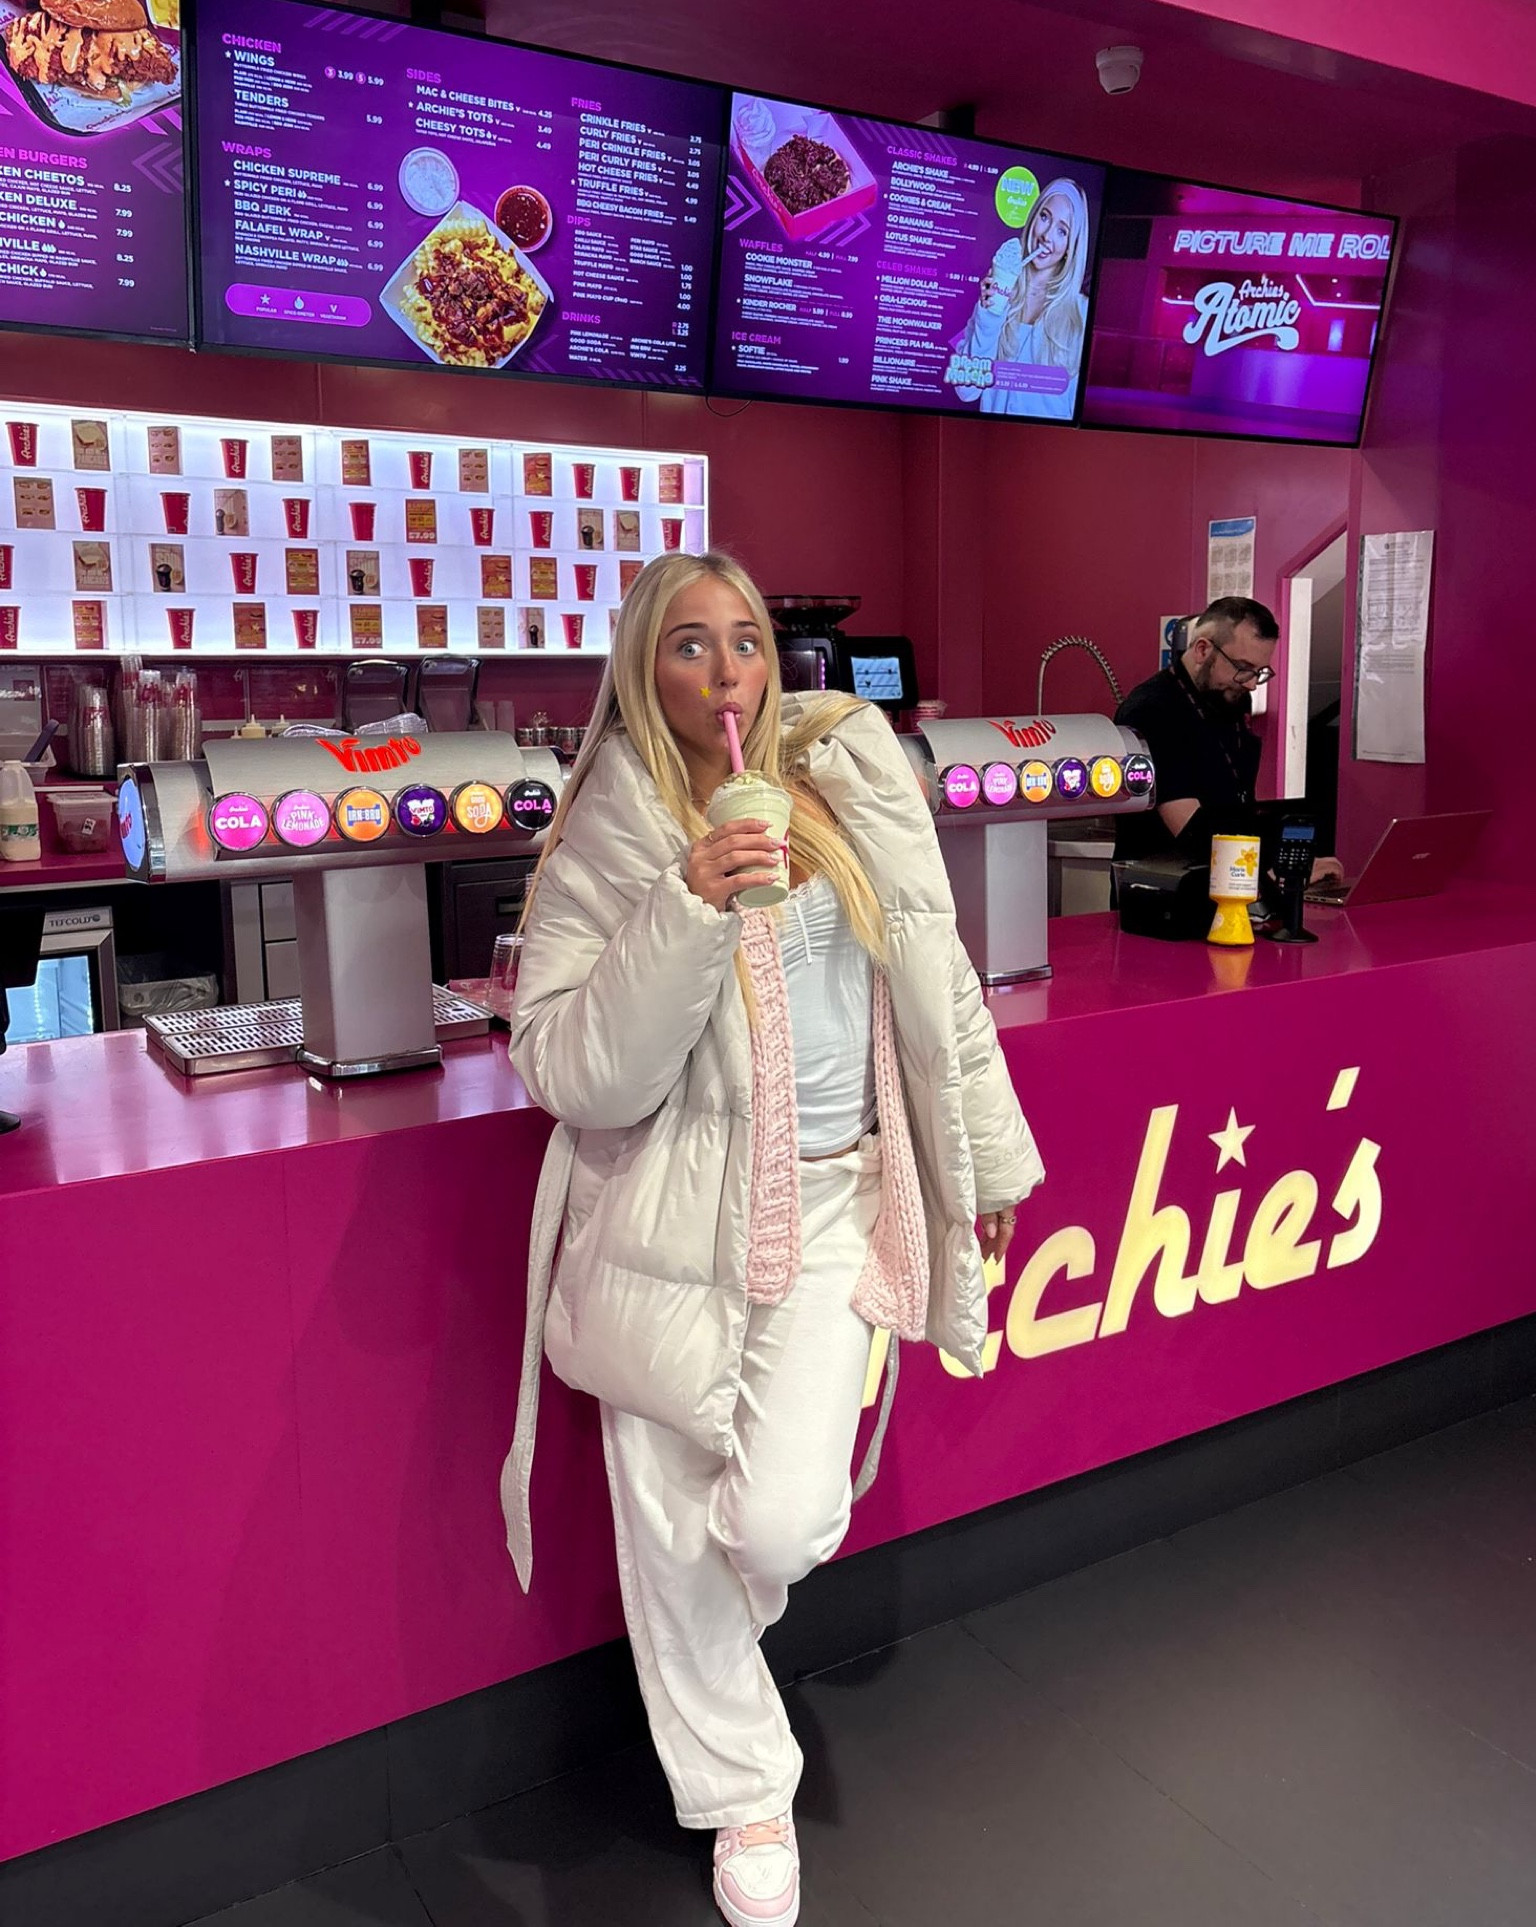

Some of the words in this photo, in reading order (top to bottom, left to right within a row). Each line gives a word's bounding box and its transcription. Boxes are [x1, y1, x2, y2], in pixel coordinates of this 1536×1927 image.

[222, 33, 282, 53] CHICKEN
[234, 50, 275, 67] WINGS
[406, 68, 442, 84] SIDES
[234, 88, 289, 108] TENDERS
[416, 84, 439, 97] MAC
[440, 89, 447, 99] &
[448, 91, 486, 107] CHEESE
[487, 98, 515, 111] BITES
[571, 97, 602, 112] FRIES
[416, 101, 466, 119] ARCHIE'S
[467, 110, 494, 124] TOTS
[415, 117, 457, 133] CHEESY
[459, 125, 486, 139] TOTS
[580, 113, 620, 129] CRINKLE
[620, 120, 646, 133] FRIES
[580, 126, 610, 139] CURLY
[611, 131, 637, 144] FRIES
[221, 141, 272, 158] WRAPS
[579, 137, 601, 150] PERI
[601, 142, 640, 156] CRINKLE
[641, 149, 667, 161] FRIES
[887, 146, 923, 160] CLASSIC
[923, 152, 958, 167] SHAKES
[19, 149, 88, 169] BURGERS
[578, 150, 600, 162] PERI
[601, 154, 630, 167] CURLY
[631, 159, 657, 171] FRIES
[24, 169, 85, 186] CHEETOS
[233, 160, 285, 177] CHICKEN
[288, 168, 341, 185] SUPREME
[578, 162, 597, 172] HOT
[597, 165, 632, 178] CHEESE
[633, 171, 659, 184] FRIES
[924, 166, 949, 179] SHAKE
[114, 183, 132, 193] 8.25
[234, 179, 268, 193] SPICY
[271, 185, 297, 198] PERI
[578, 177, 618, 192] TRUFFLE
[619, 184, 644, 197] FRIES
[890, 176, 937, 192] BOLLYWOOD
[1000, 176, 1035, 196] NEW
[26, 194, 77, 211] DELUXE
[234, 199, 260, 211] BBQ
[262, 203, 291, 217] JERK
[889, 192, 921, 206] COOKIES
[926, 199, 952, 211] CREAM
[115, 208, 133, 218] 7.99
[567, 215, 592, 228] DIPS
[643, 208, 664, 219] FRIES
[235, 219, 286, 236] FALAFEL
[288, 227, 323, 240] WRAP
[898, 215, 934, 229] BANANAS
[116, 228, 133, 238] 7.99
[885, 231, 909, 242] LOTUS
[909, 234, 934, 246] SHAKE
[739, 238, 784, 253] WAFFLES
[1173, 229, 1286, 256] PICTURE
[1287, 232, 1336, 258] ME
[116, 253, 134, 263] 8.25
[235, 243, 300, 261] NASHVILLE
[302, 252, 337, 265] WRAP
[745, 252, 775, 264] COOKIE
[776, 256, 813, 269] MONSTER
[904, 264, 938, 277] SHAKES
[118, 278, 135, 288] 7.99
[744, 273, 793, 288] SNOWFLAKE
[881, 274, 911, 286] MILLION
[910, 278, 939, 290] DOLLAR
[742, 298, 769, 308] KINDER
[768, 301, 797, 312] ROCHER
[562, 311, 601, 324] DRINKS
[877, 315, 893, 325] THE
[892, 317, 943, 330] MOONWALKER
[1182, 281, 1302, 357] Atomic
[731, 331, 748, 341] ICE
[748, 333, 782, 345] CREAM
[875, 335, 909, 347] PRINCESS
[738, 344, 766, 356] SOFTIE
[984, 719, 1056, 748] Vimto
[315, 736, 422, 774] Vimto
[1127, 770, 1153, 782] COLA
[947, 781, 977, 793] COLA
[514, 798, 552, 812] COLA
[215, 815, 262, 830] COLA
[290, 809, 315, 820] PINK
[466, 802, 493, 828] SODA
[281, 817, 325, 832] LEMONADE
[862, 1066, 1382, 1409] chie's
